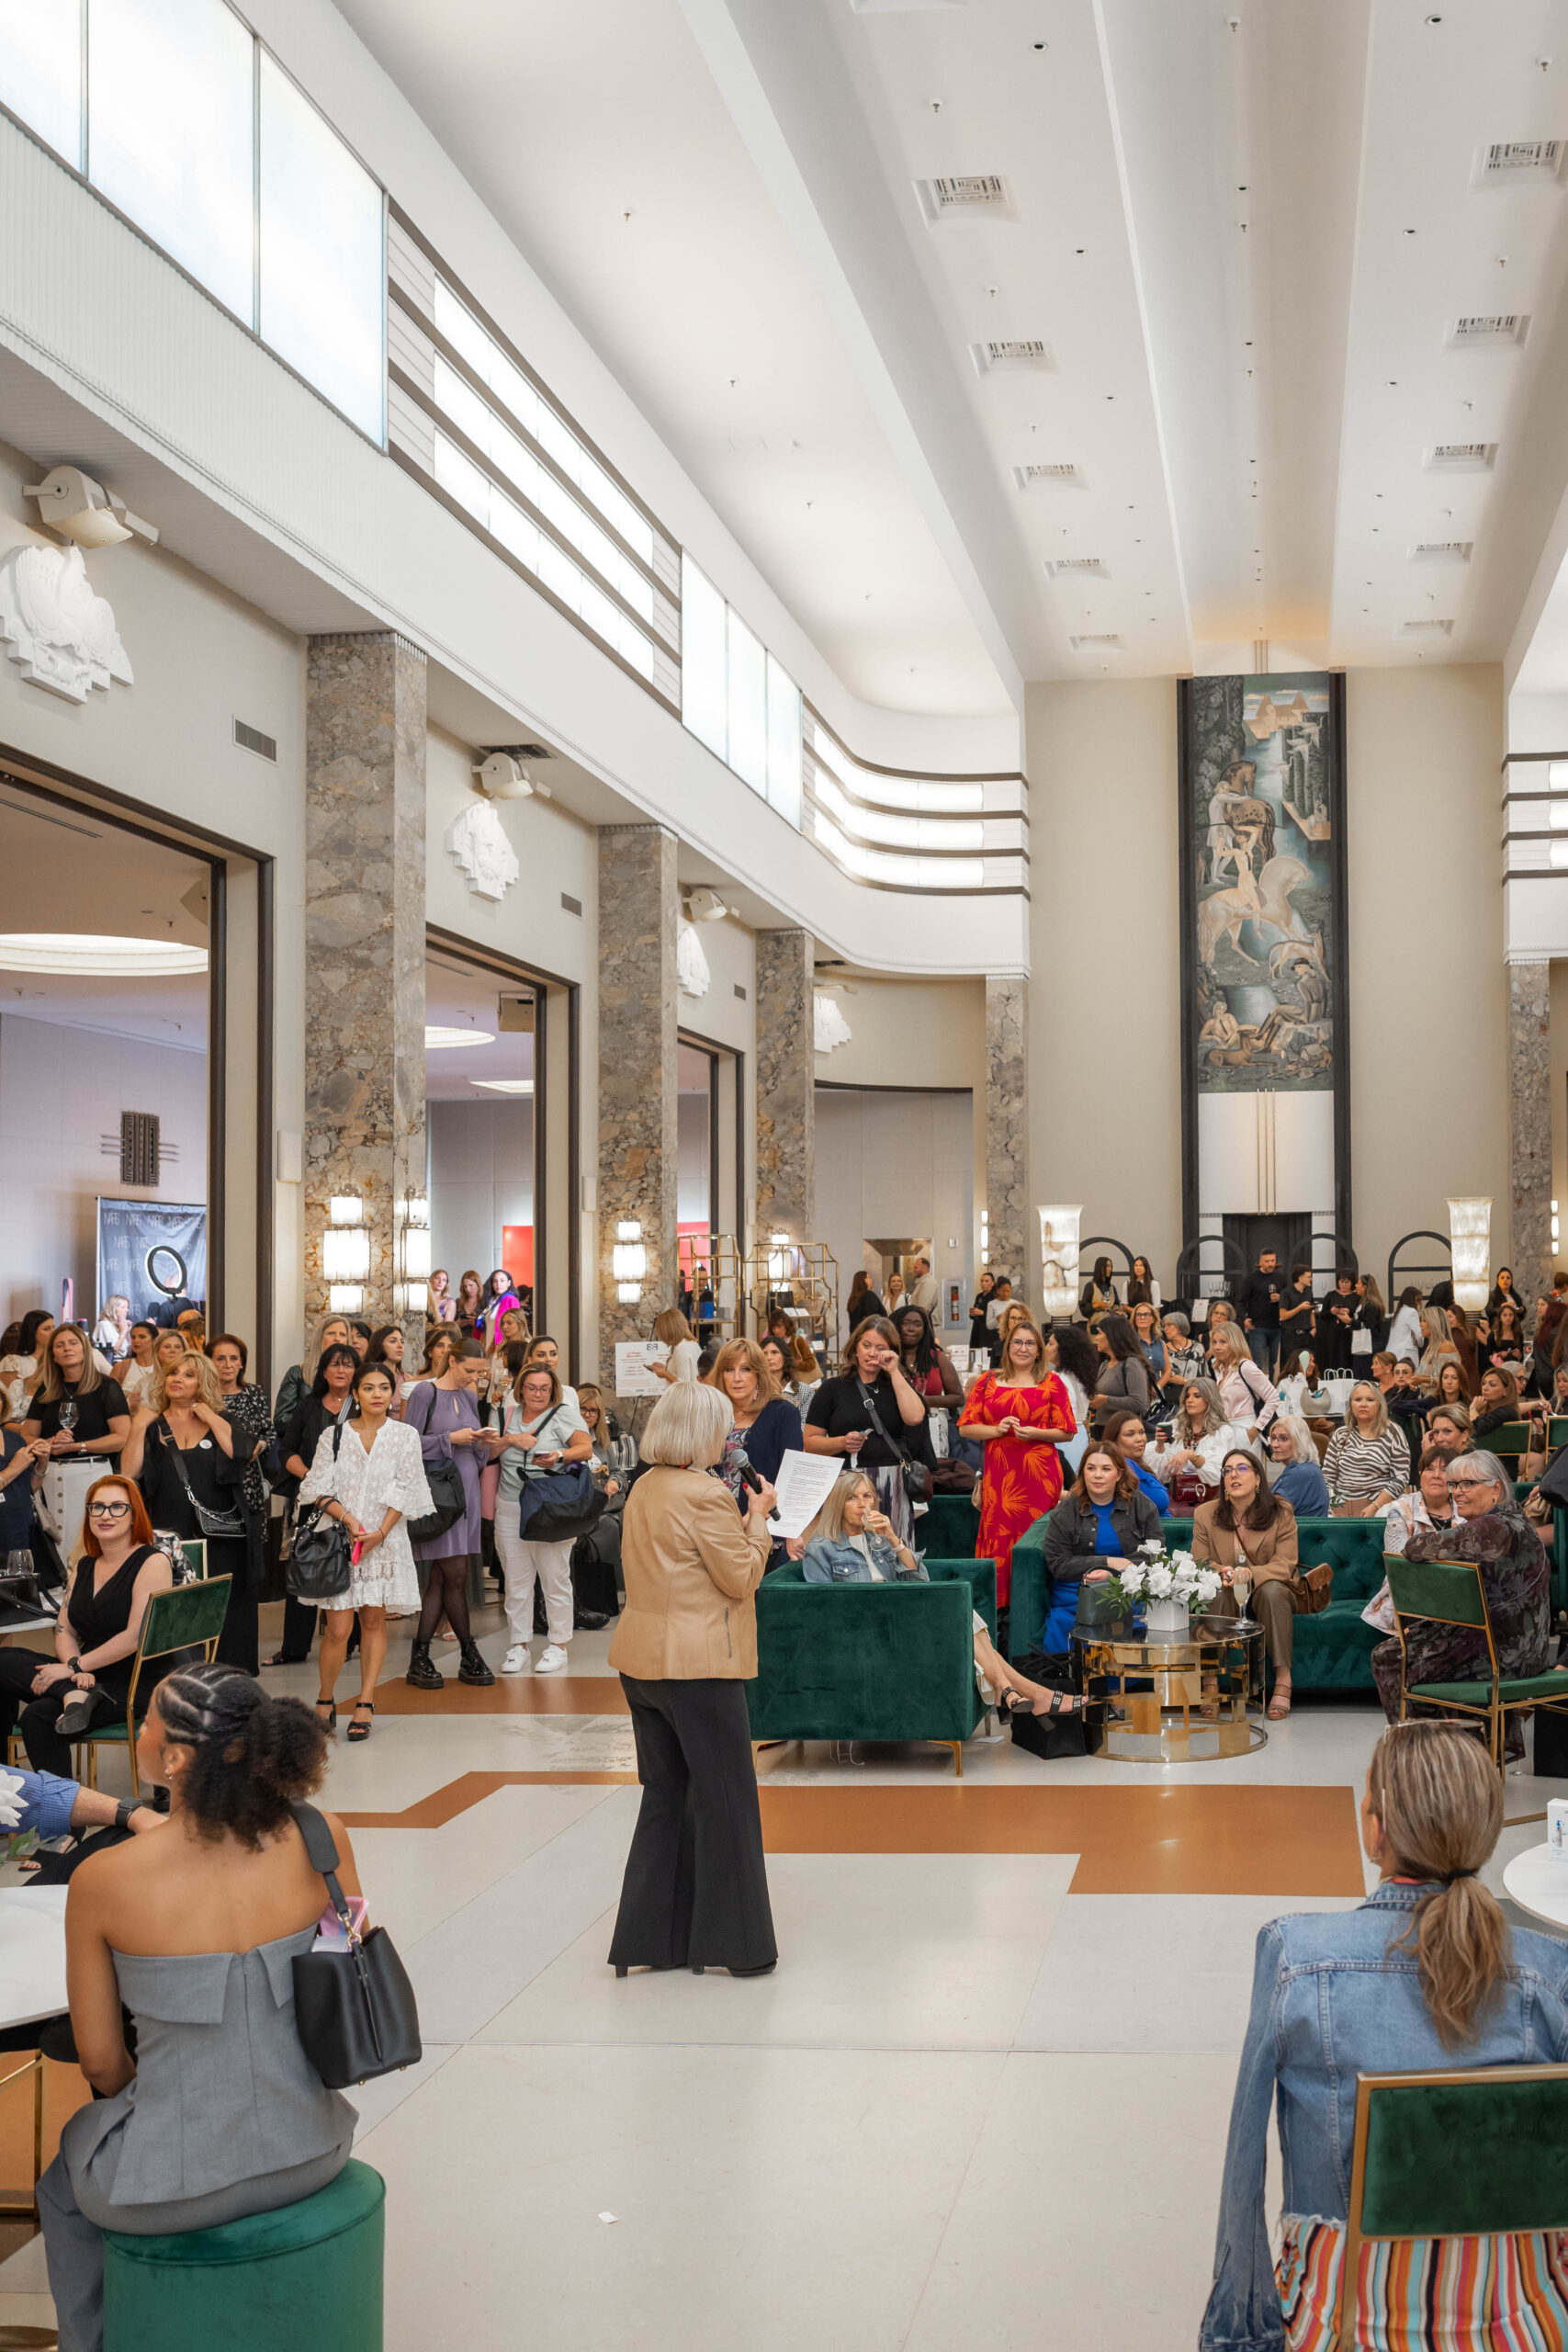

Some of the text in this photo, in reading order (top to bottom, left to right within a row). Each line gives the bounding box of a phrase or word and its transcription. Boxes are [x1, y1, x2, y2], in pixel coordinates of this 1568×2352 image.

[104, 1213, 120, 1225] NARS
[126, 1214, 141, 1226] NARS
[114, 1235, 130, 1249] NARS
[104, 1258, 119, 1272] NARS
